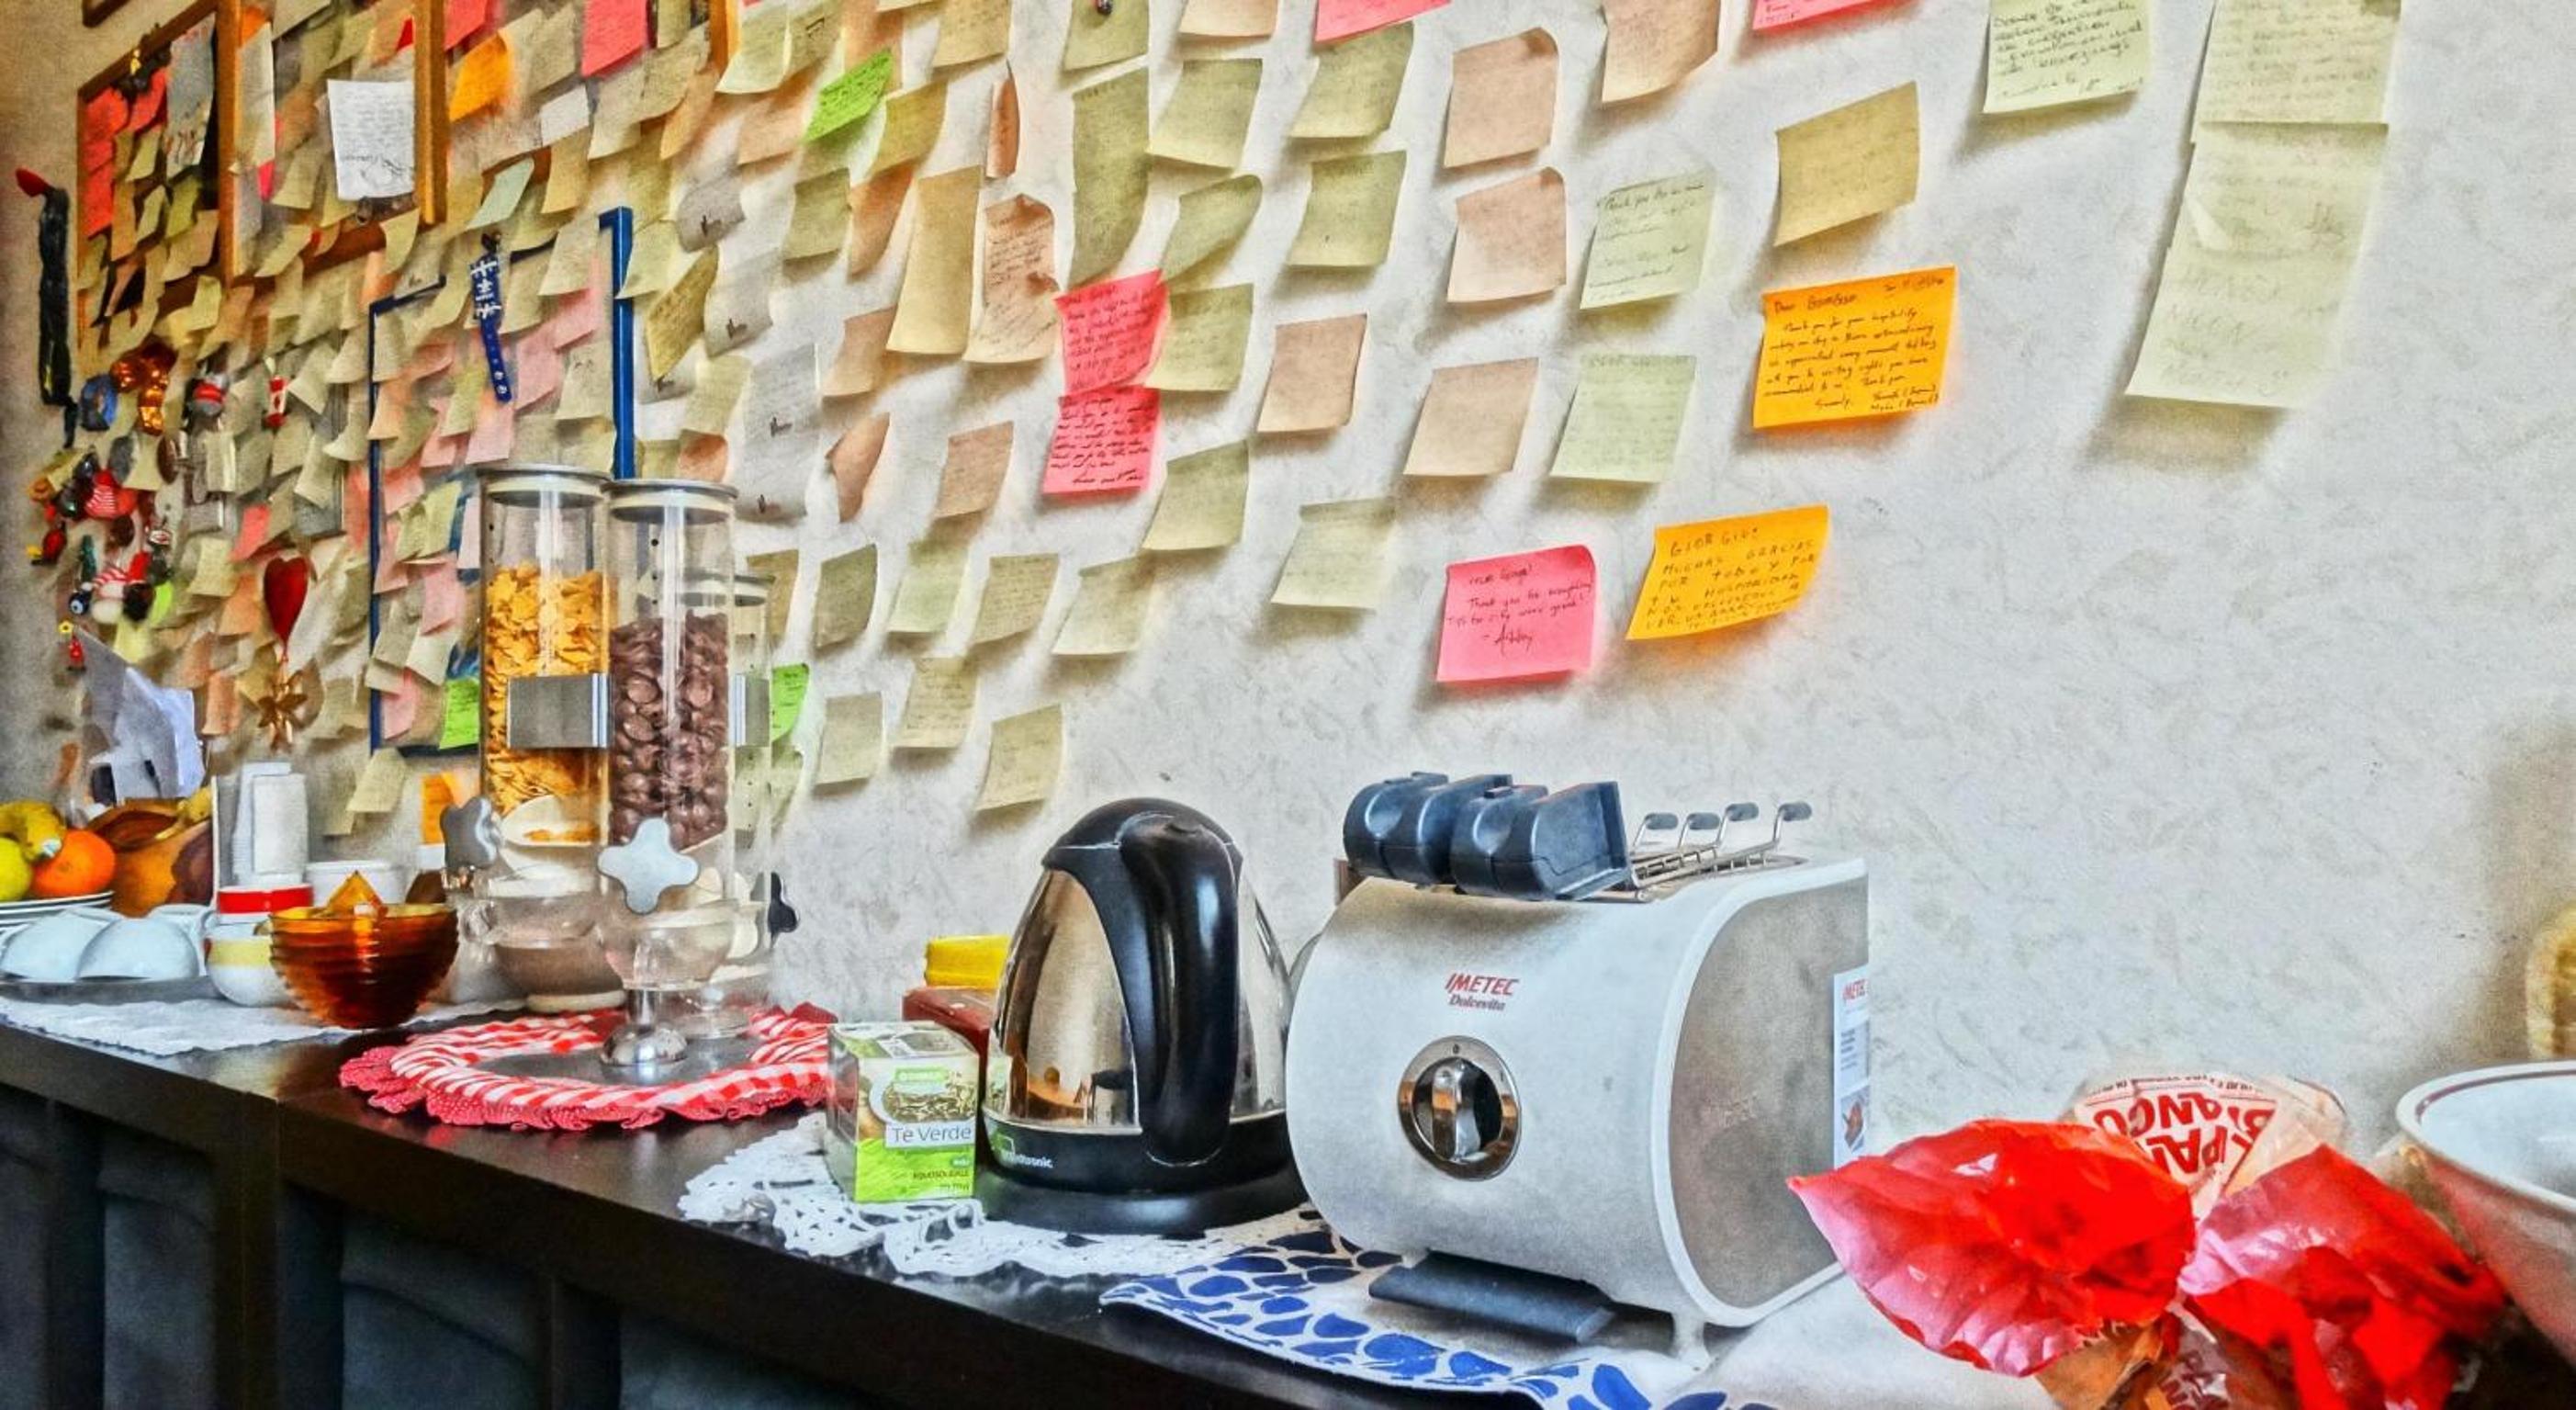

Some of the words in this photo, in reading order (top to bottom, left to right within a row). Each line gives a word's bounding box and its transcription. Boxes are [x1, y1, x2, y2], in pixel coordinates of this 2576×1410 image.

[1445, 973, 1520, 997] IMETEC
[1448, 994, 1506, 1011] Dolcevita
[891, 1126, 916, 1144] Te
[917, 1123, 973, 1143] Verde
